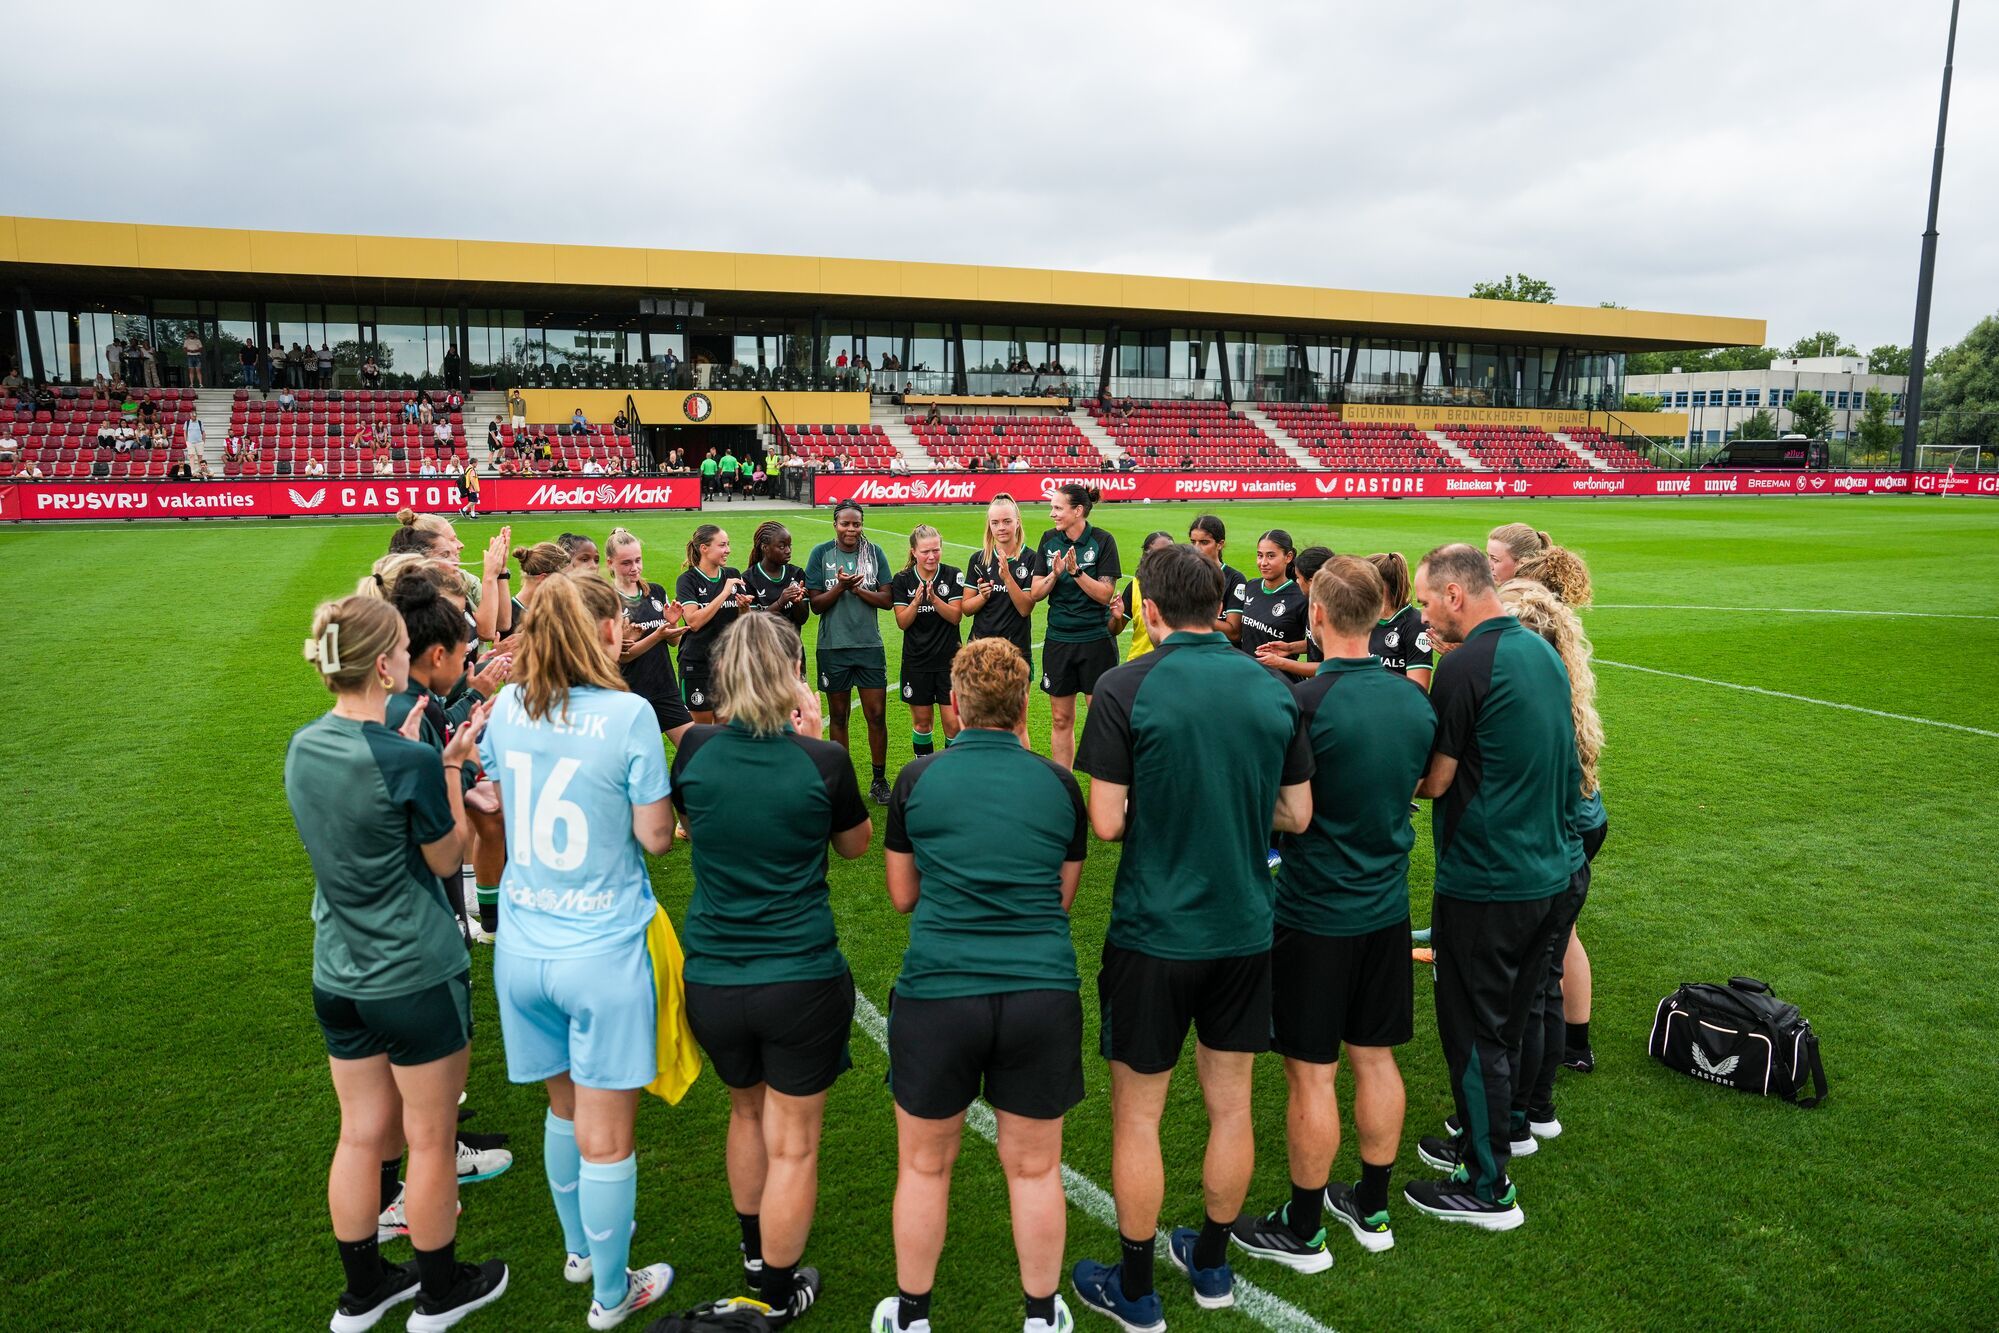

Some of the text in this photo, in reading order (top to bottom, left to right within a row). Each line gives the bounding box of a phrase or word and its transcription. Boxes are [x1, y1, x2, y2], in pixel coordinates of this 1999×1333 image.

[1347, 407, 1585, 423] GIOVANNI VAN BRONCKHORST TRIBUNE
[851, 479, 976, 499] Media Markt
[1242, 480, 1297, 492] vakanties
[1344, 477, 1424, 492] CASTORE
[1446, 479, 1492, 490] Heineken
[1656, 476, 1691, 492] univé
[1704, 475, 1737, 491] univé
[1748, 478, 1791, 488] BREEMAN
[157, 492, 255, 509] vakanties
[341, 487, 480, 506] CASTOR
[527, 483, 673, 505] Media Markt
[552, 711, 609, 740] EIJK
[505, 750, 588, 872] 16
[1691, 1068, 1735, 1087] CASTORE
